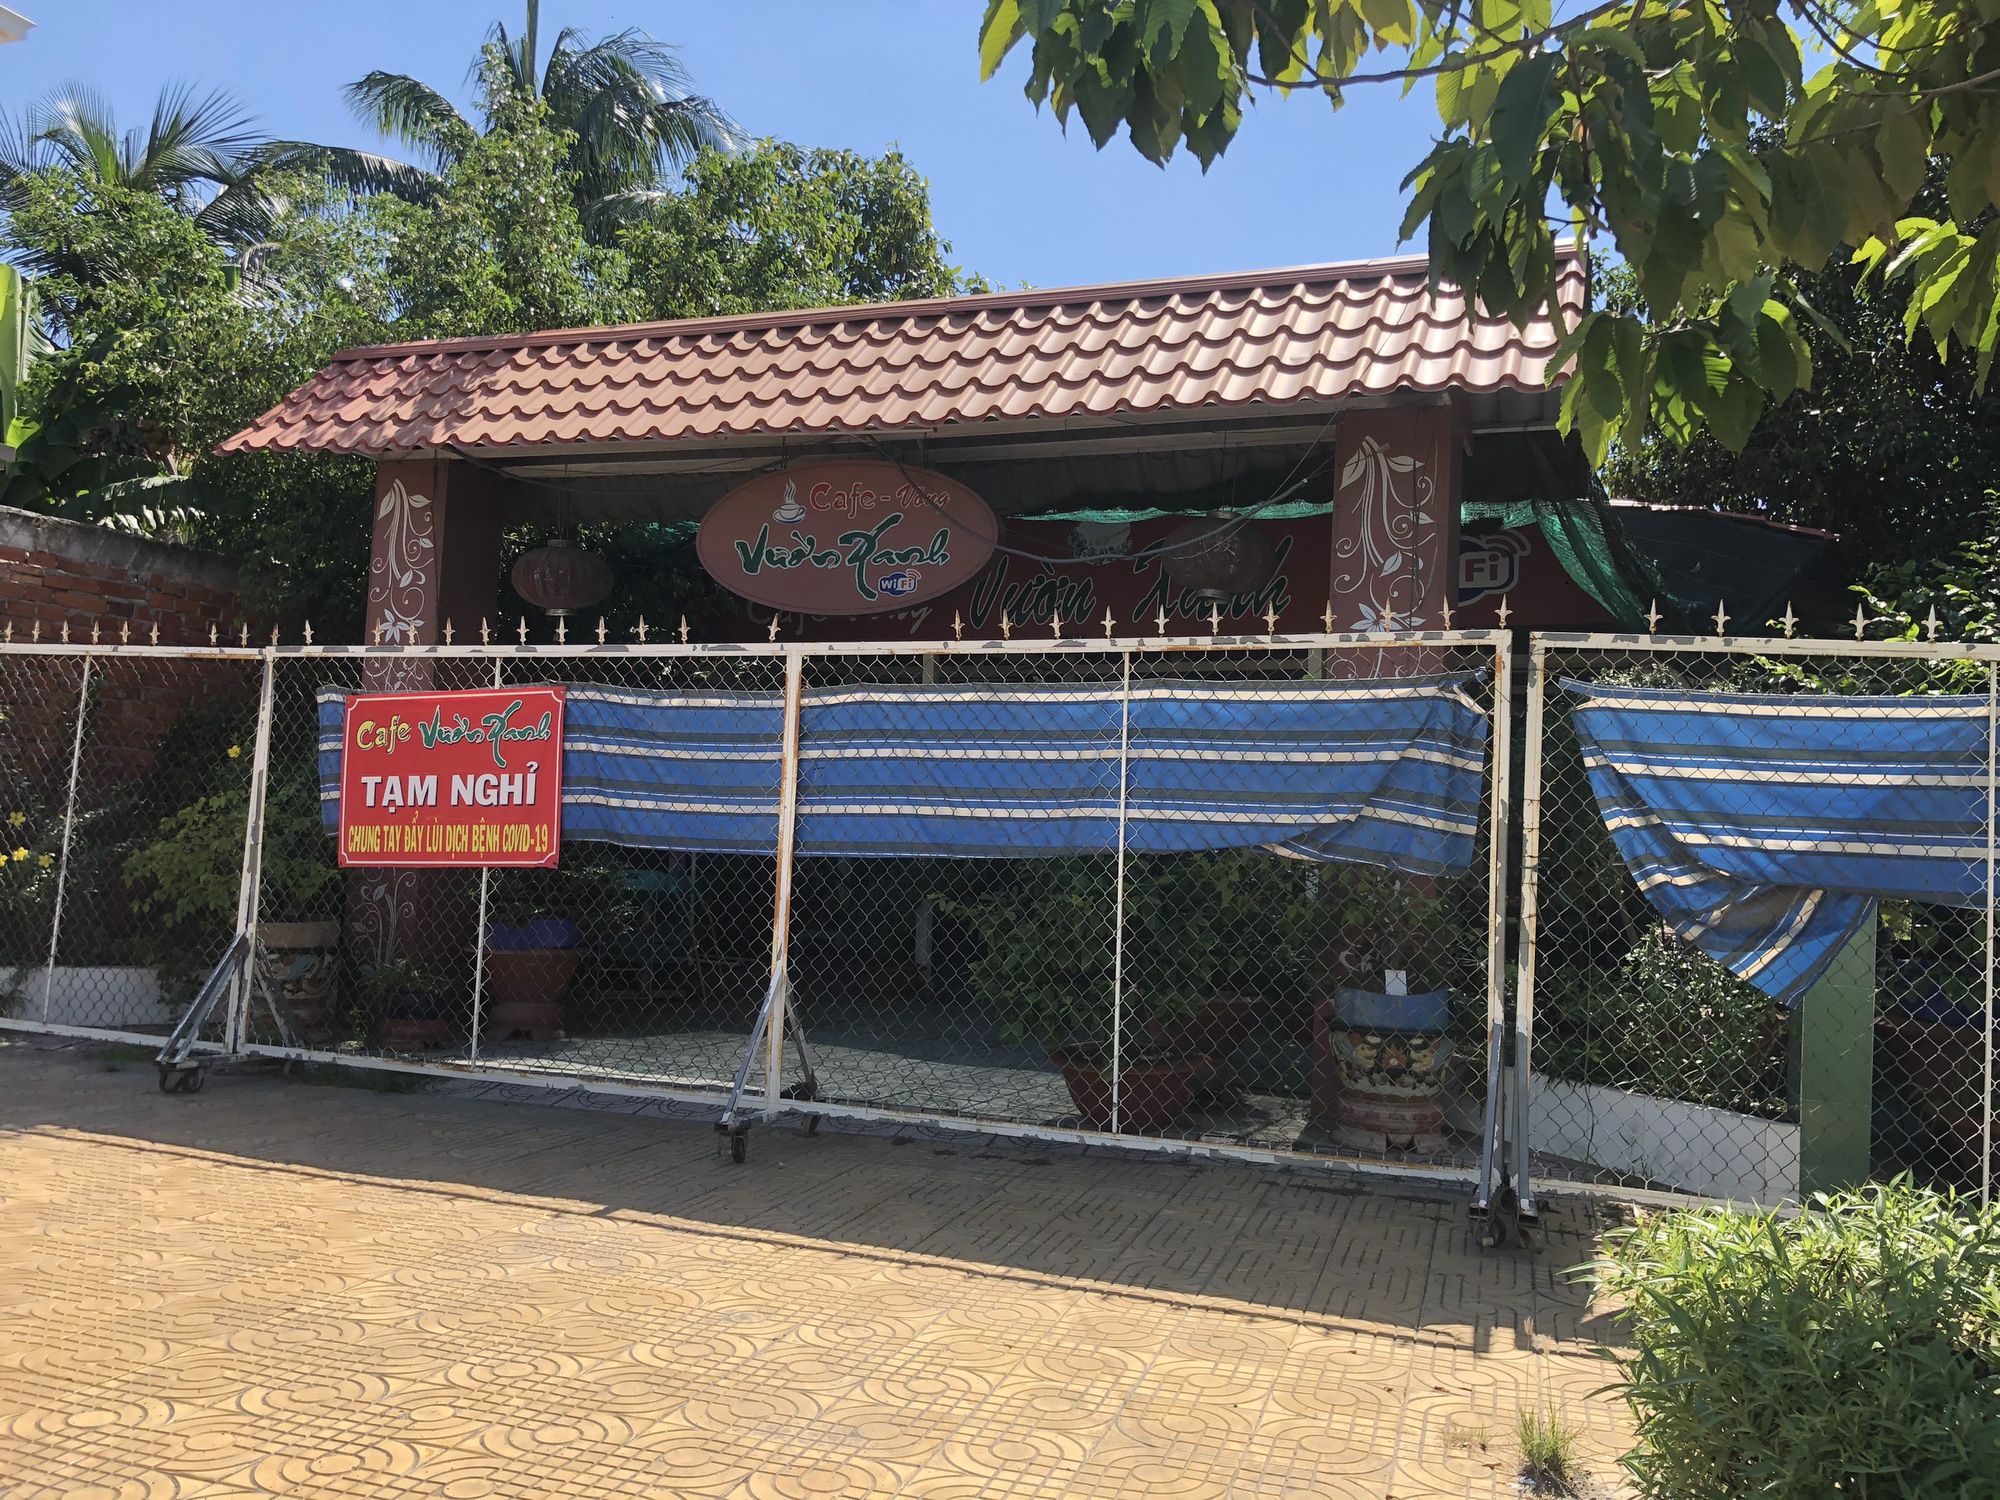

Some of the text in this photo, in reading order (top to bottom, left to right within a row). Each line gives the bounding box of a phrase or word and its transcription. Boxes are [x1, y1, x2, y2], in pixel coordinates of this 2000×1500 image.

[809, 481, 876, 519] Cafe
[734, 512, 951, 602] Vườn Xanh
[356, 699, 552, 768] Cafe Vườn Xanh
[361, 761, 539, 813] TẠM NGHỈ
[348, 810, 548, 859] CHUNG TAY ĐẨY LÙI DỊCH BỆNH COVID-19
